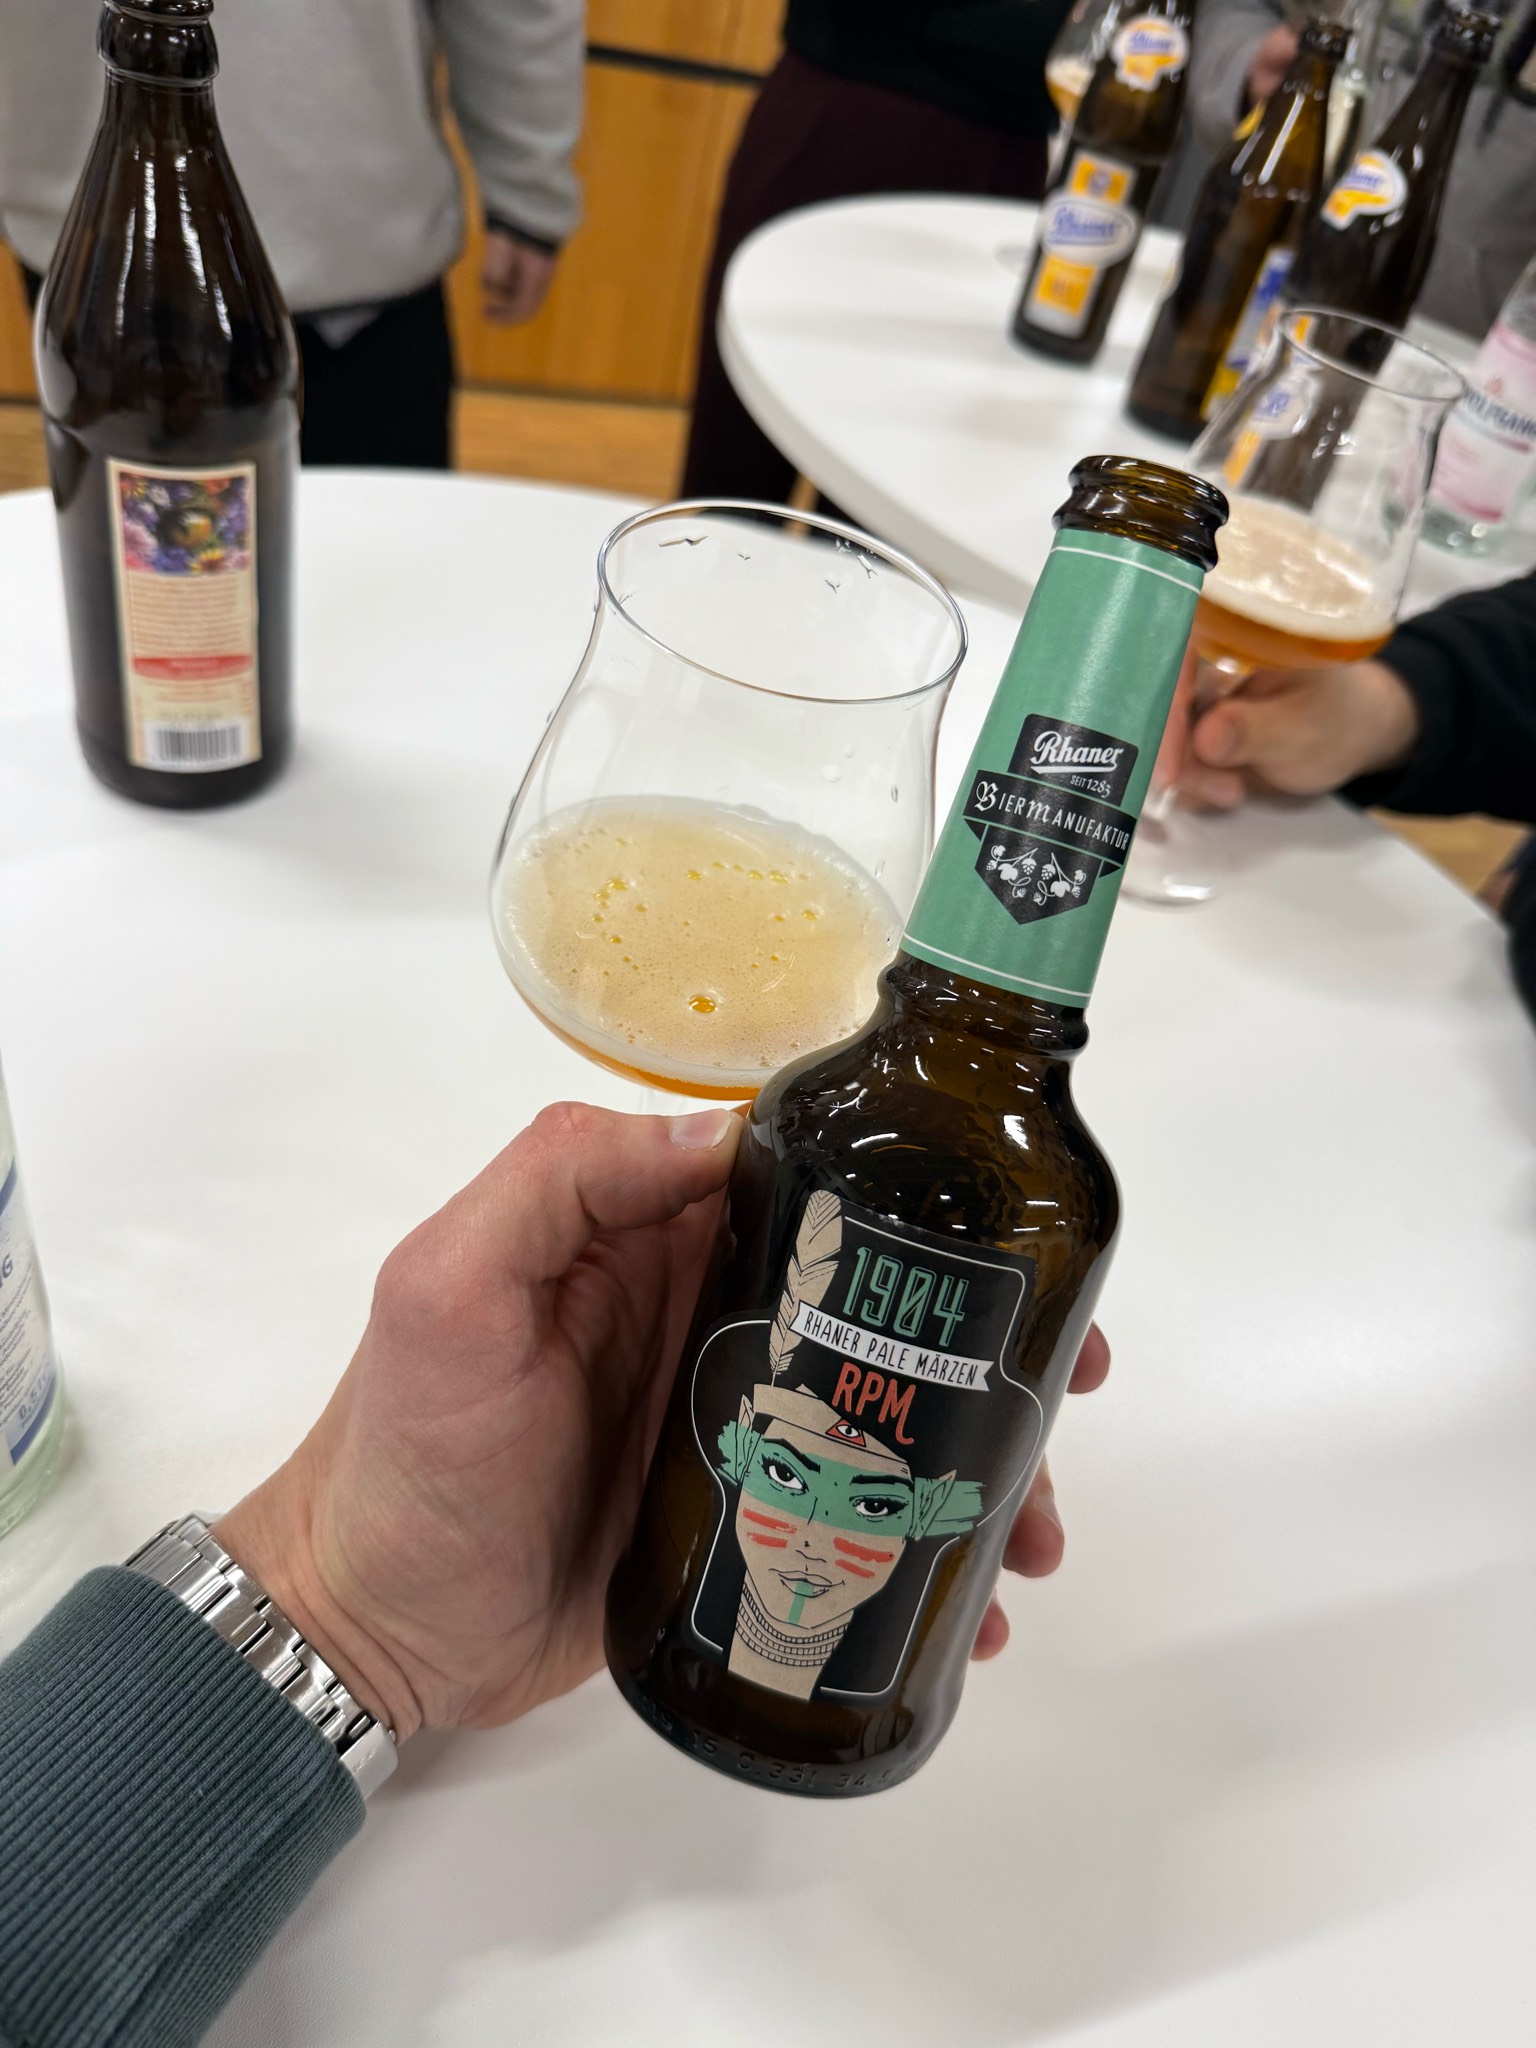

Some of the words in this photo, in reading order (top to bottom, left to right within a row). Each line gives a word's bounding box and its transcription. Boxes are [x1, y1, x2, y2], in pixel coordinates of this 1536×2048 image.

[1031, 731, 1124, 771] Rhaner
[1070, 774, 1087, 789] SEIT
[1087, 778, 1111, 798] 1283
[842, 1246, 969, 1347] 1904
[804, 1311, 859, 1354] RHANER
[866, 1337, 910, 1371] PALE
[914, 1353, 979, 1386] MÄRZEN
[831, 1361, 916, 1445] RPM
